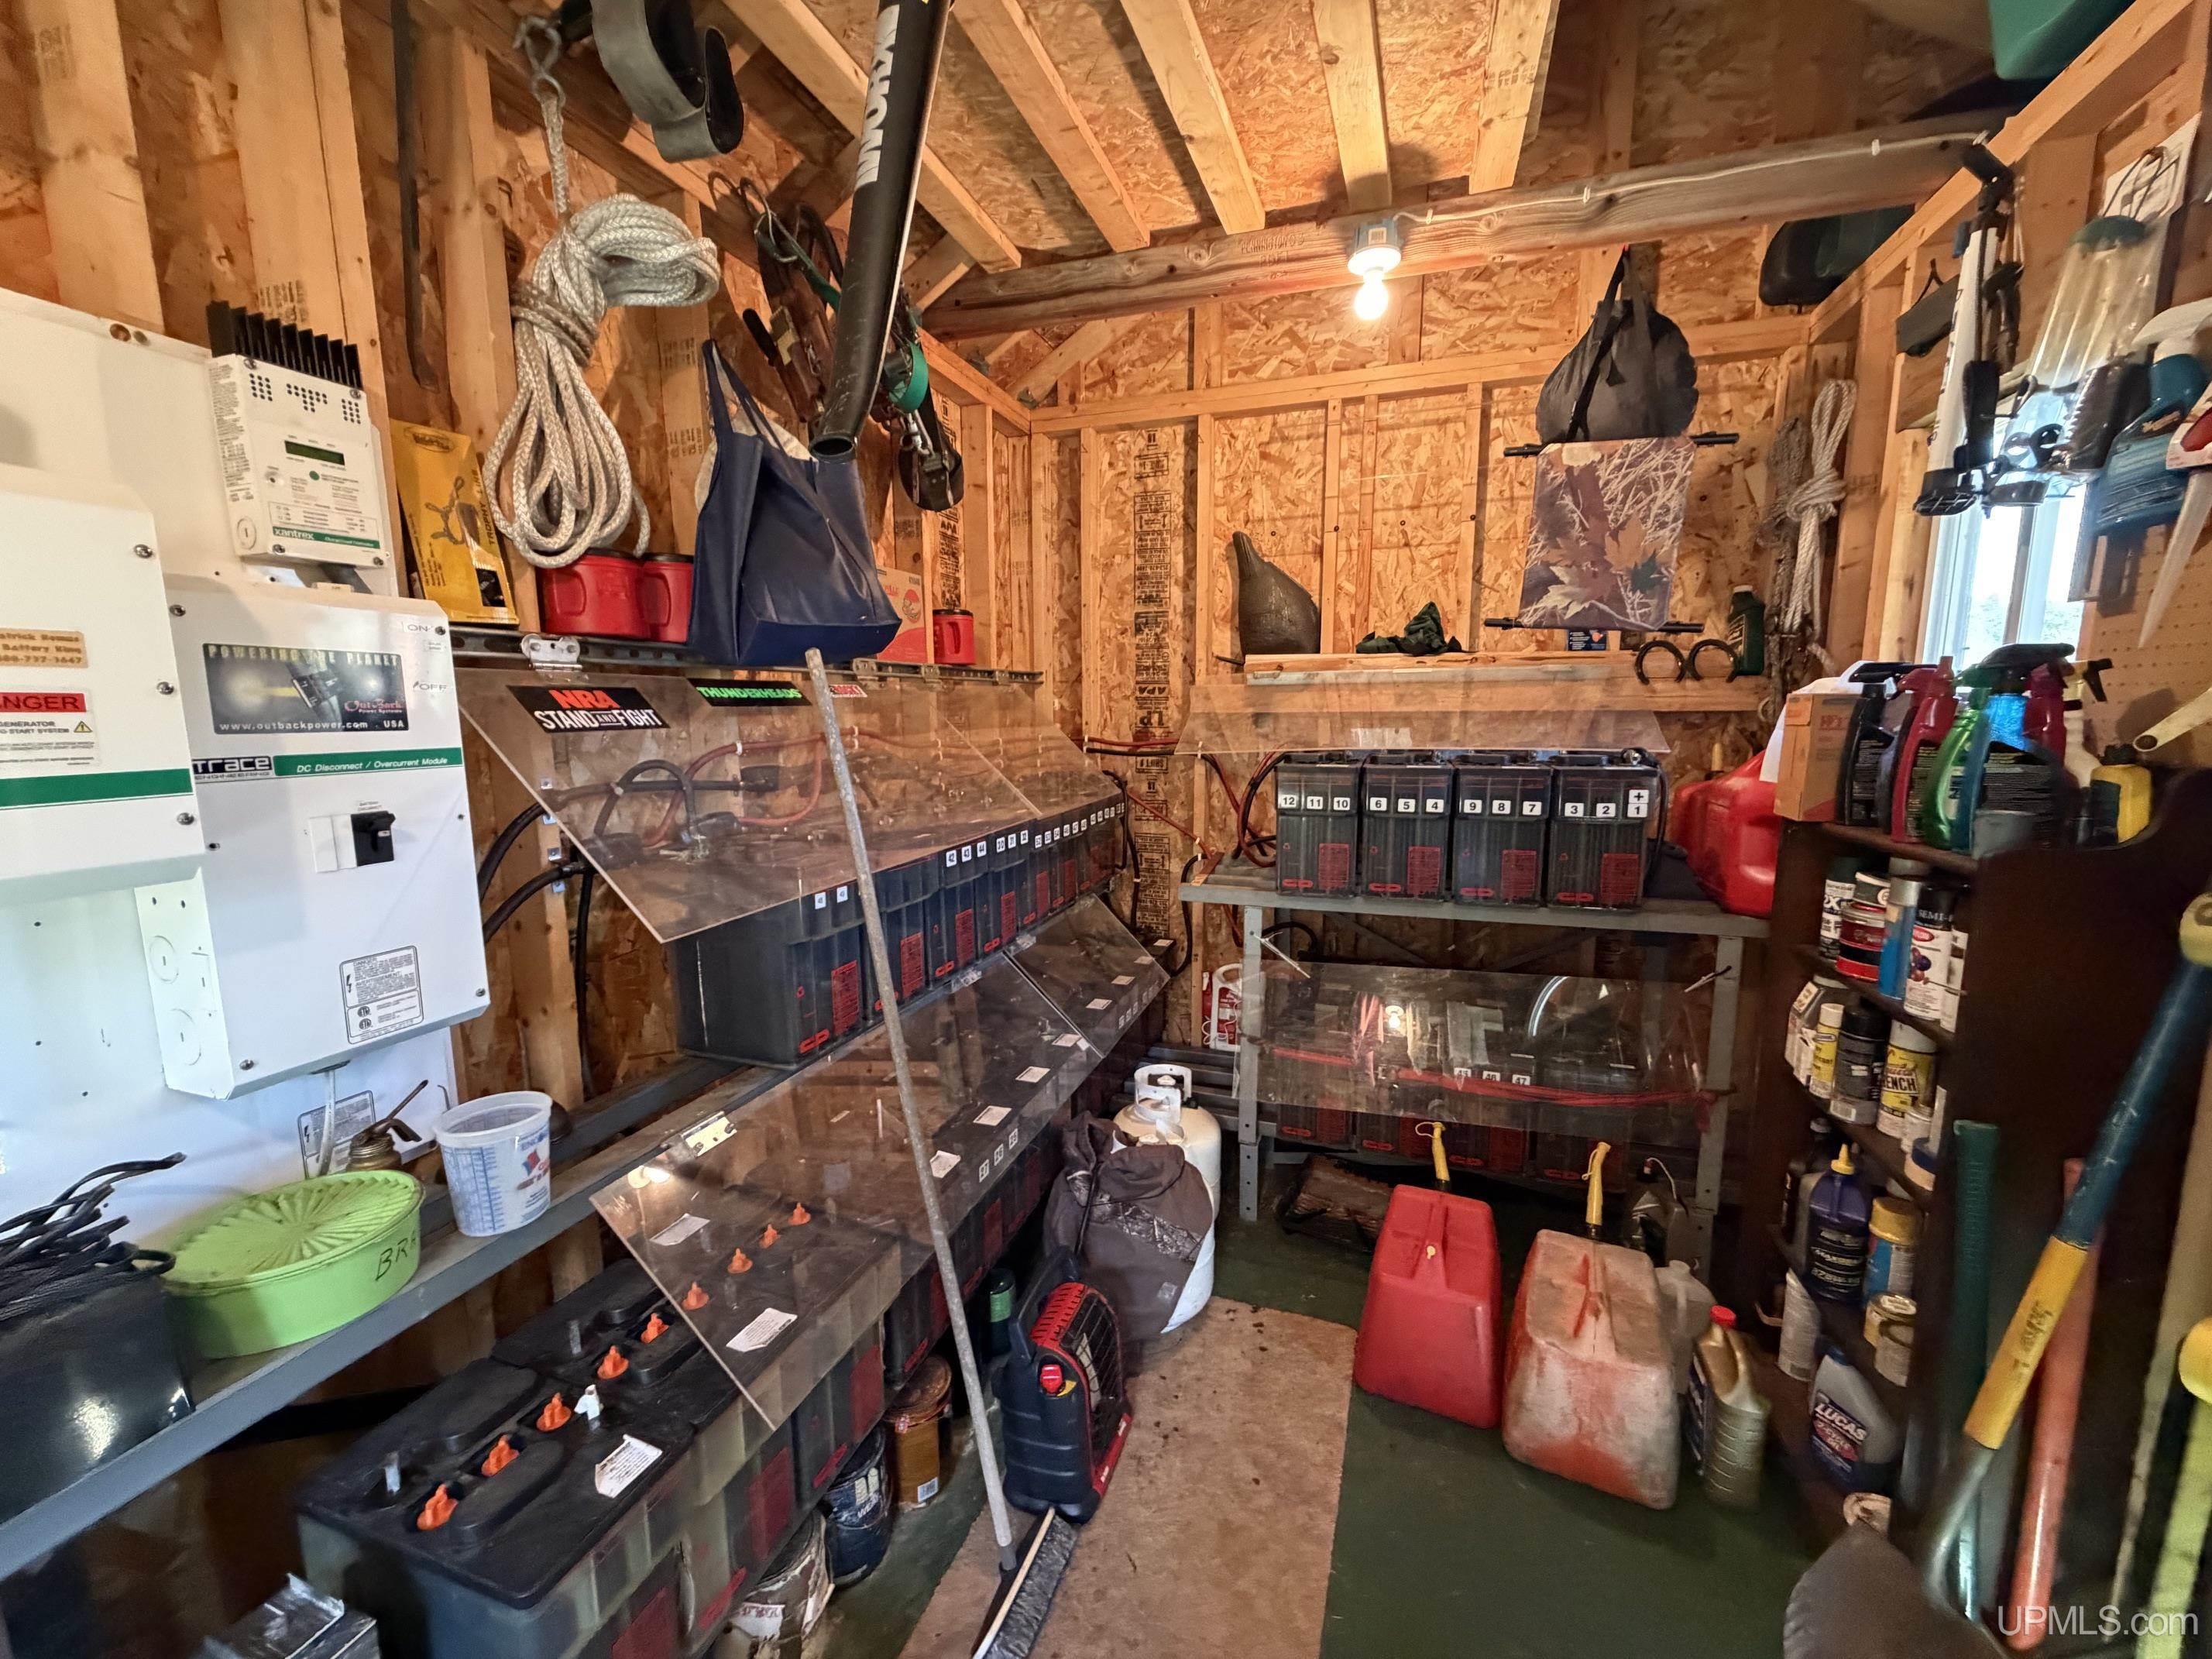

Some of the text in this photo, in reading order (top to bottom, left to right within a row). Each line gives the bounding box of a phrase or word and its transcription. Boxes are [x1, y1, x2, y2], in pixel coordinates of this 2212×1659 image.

[480, 500, 496, 545] TROPHY
[273, 527, 314, 541] xantrex
[407, 623, 428, 632] ON
[208, 644, 298, 662] POWERING
[347, 654, 400, 667] PLANET
[419, 682, 447, 691] OFF
[696, 685, 802, 699] THUNDERHEADS
[0, 696, 80, 709] NGER
[549, 689, 620, 709] NRA
[219, 720, 404, 730] www.outbackpower.com USA
[534, 710, 599, 730] STAND
[611, 709, 663, 726] FIGHT
[314, 761, 363, 772] Disconnect
[373, 759, 420, 769] Overcurrent
[421, 756, 448, 765] Module
[1283, 796, 1348, 808] 12 11 10
[1374, 799, 1439, 811] 6 5 4
[1468, 802, 1537, 813] 9 8 7
[1570, 805, 1640, 816] 3 2 1
[963, 850, 970, 858] 43
[978, 845, 984, 854] 44
[1814, 1403, 1867, 1441] LUCAS
